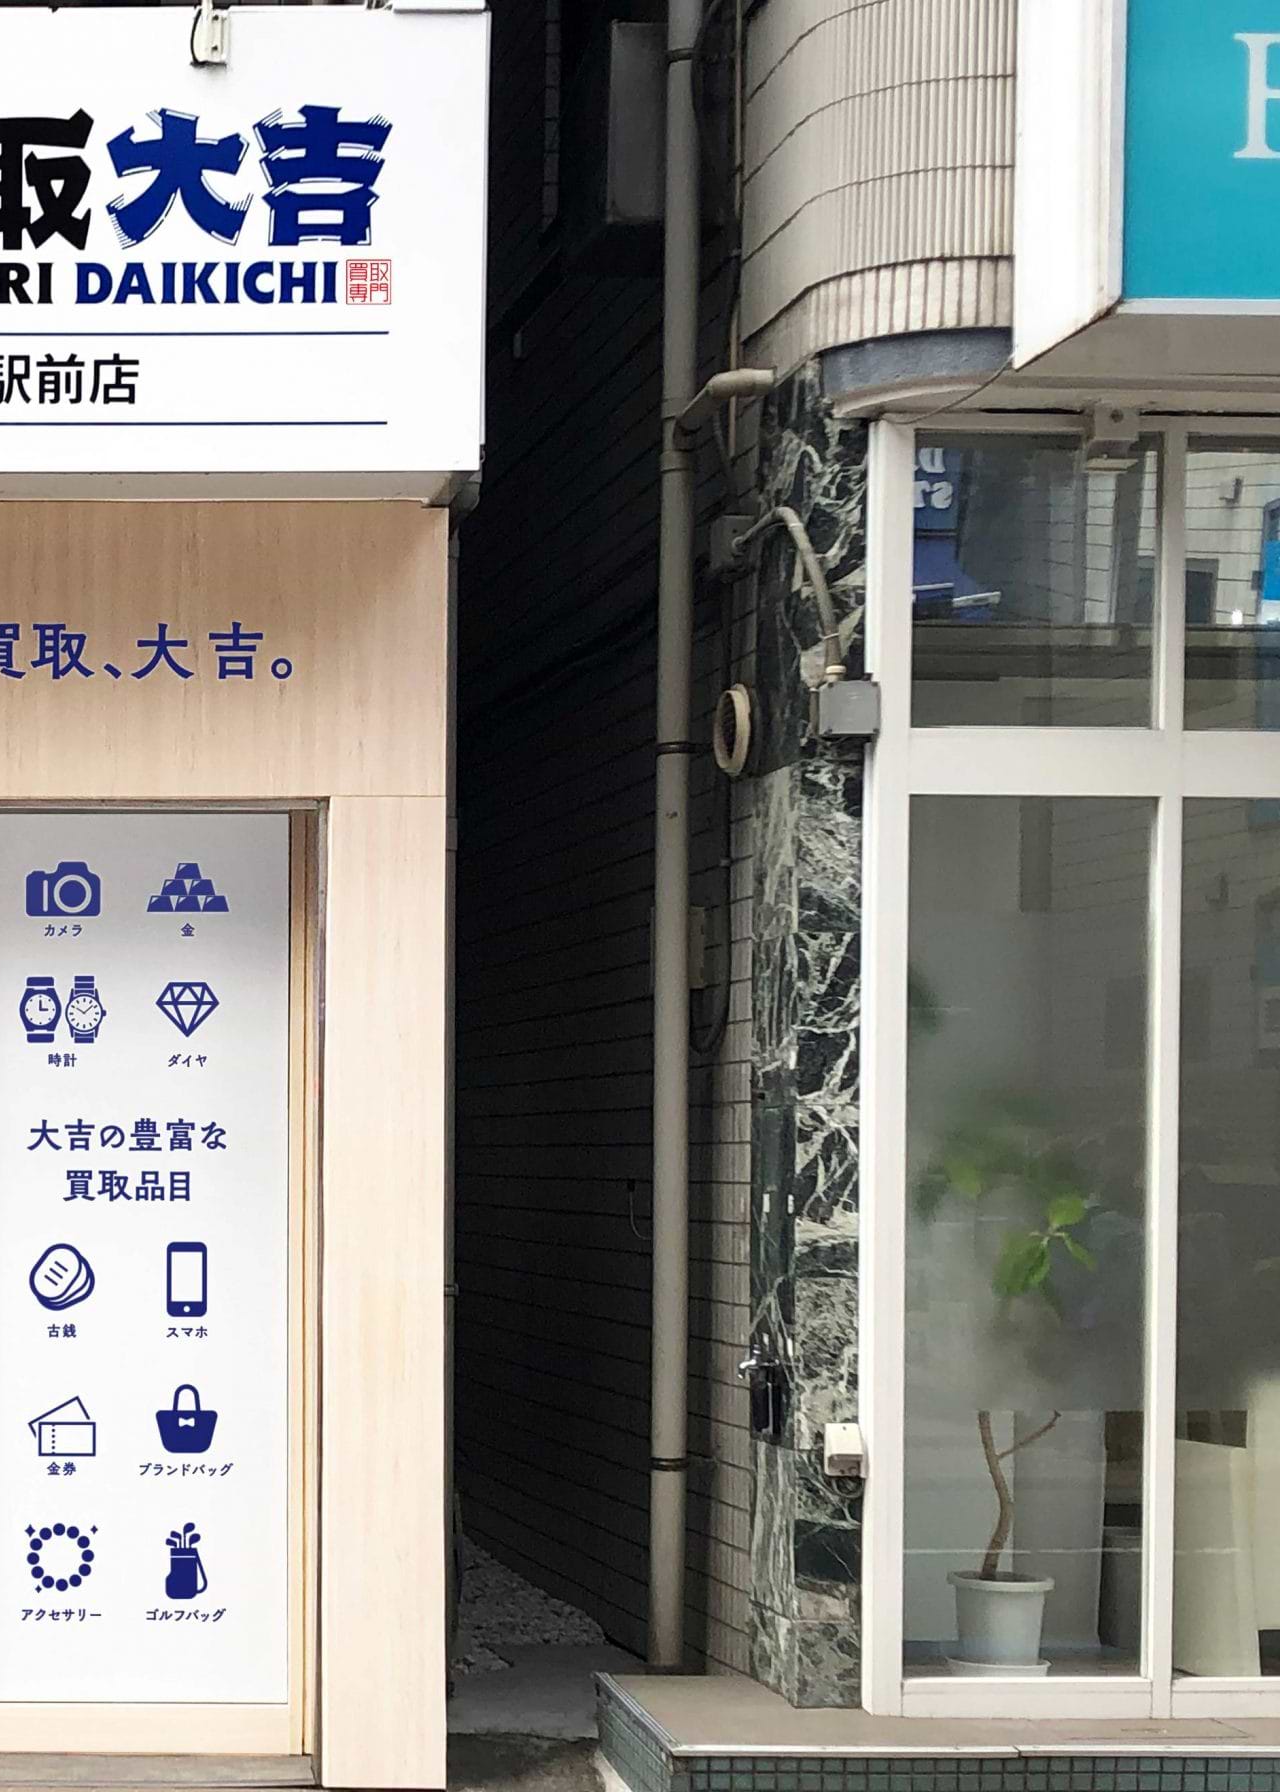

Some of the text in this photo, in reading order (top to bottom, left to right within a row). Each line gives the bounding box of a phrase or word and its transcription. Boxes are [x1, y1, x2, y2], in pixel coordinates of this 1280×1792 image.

[75, 261, 338, 305] DAIKICHI
[44, 923, 83, 937] カメラ
[180, 922, 195, 937] 金
[47, 1053, 78, 1067] 時計
[168, 1053, 207, 1067] ダイヤ
[27, 1118, 227, 1152] 大吉の豊富な
[63, 1170, 191, 1202] 買取品目
[47, 1323, 78, 1339] 古銭
[166, 1325, 208, 1339] スマホ
[47, 1462, 77, 1477] 金券
[138, 1462, 234, 1477] ブランドバッグ
[22, 1608, 102, 1622] アクセサリー
[145, 1607, 227, 1622] ゴルフバッグ
